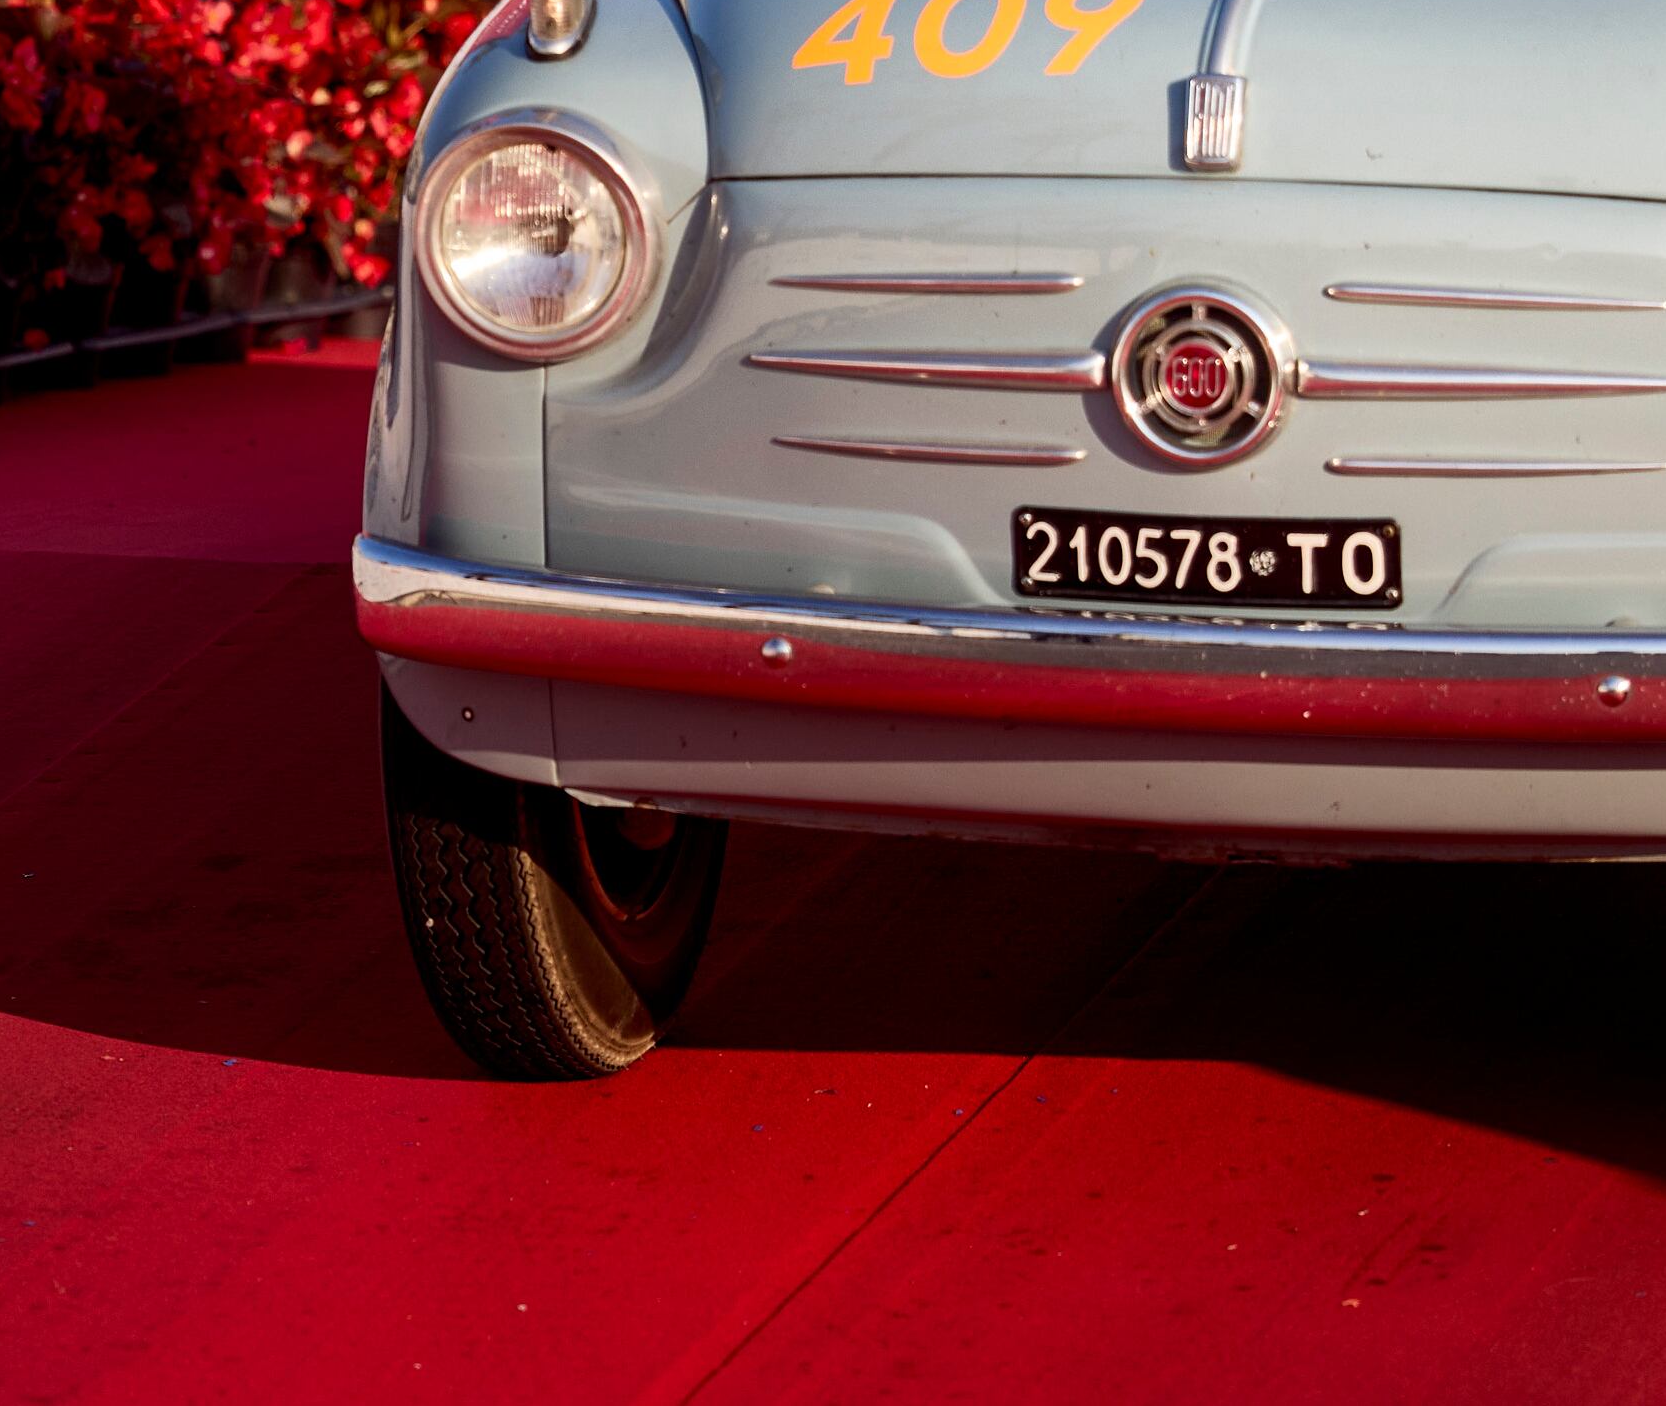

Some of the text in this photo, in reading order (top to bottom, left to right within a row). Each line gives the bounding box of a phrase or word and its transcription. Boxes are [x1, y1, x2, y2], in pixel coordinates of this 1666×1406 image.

[1171, 355, 1222, 397] 600
[1026, 521, 1385, 595] 210578 TO
